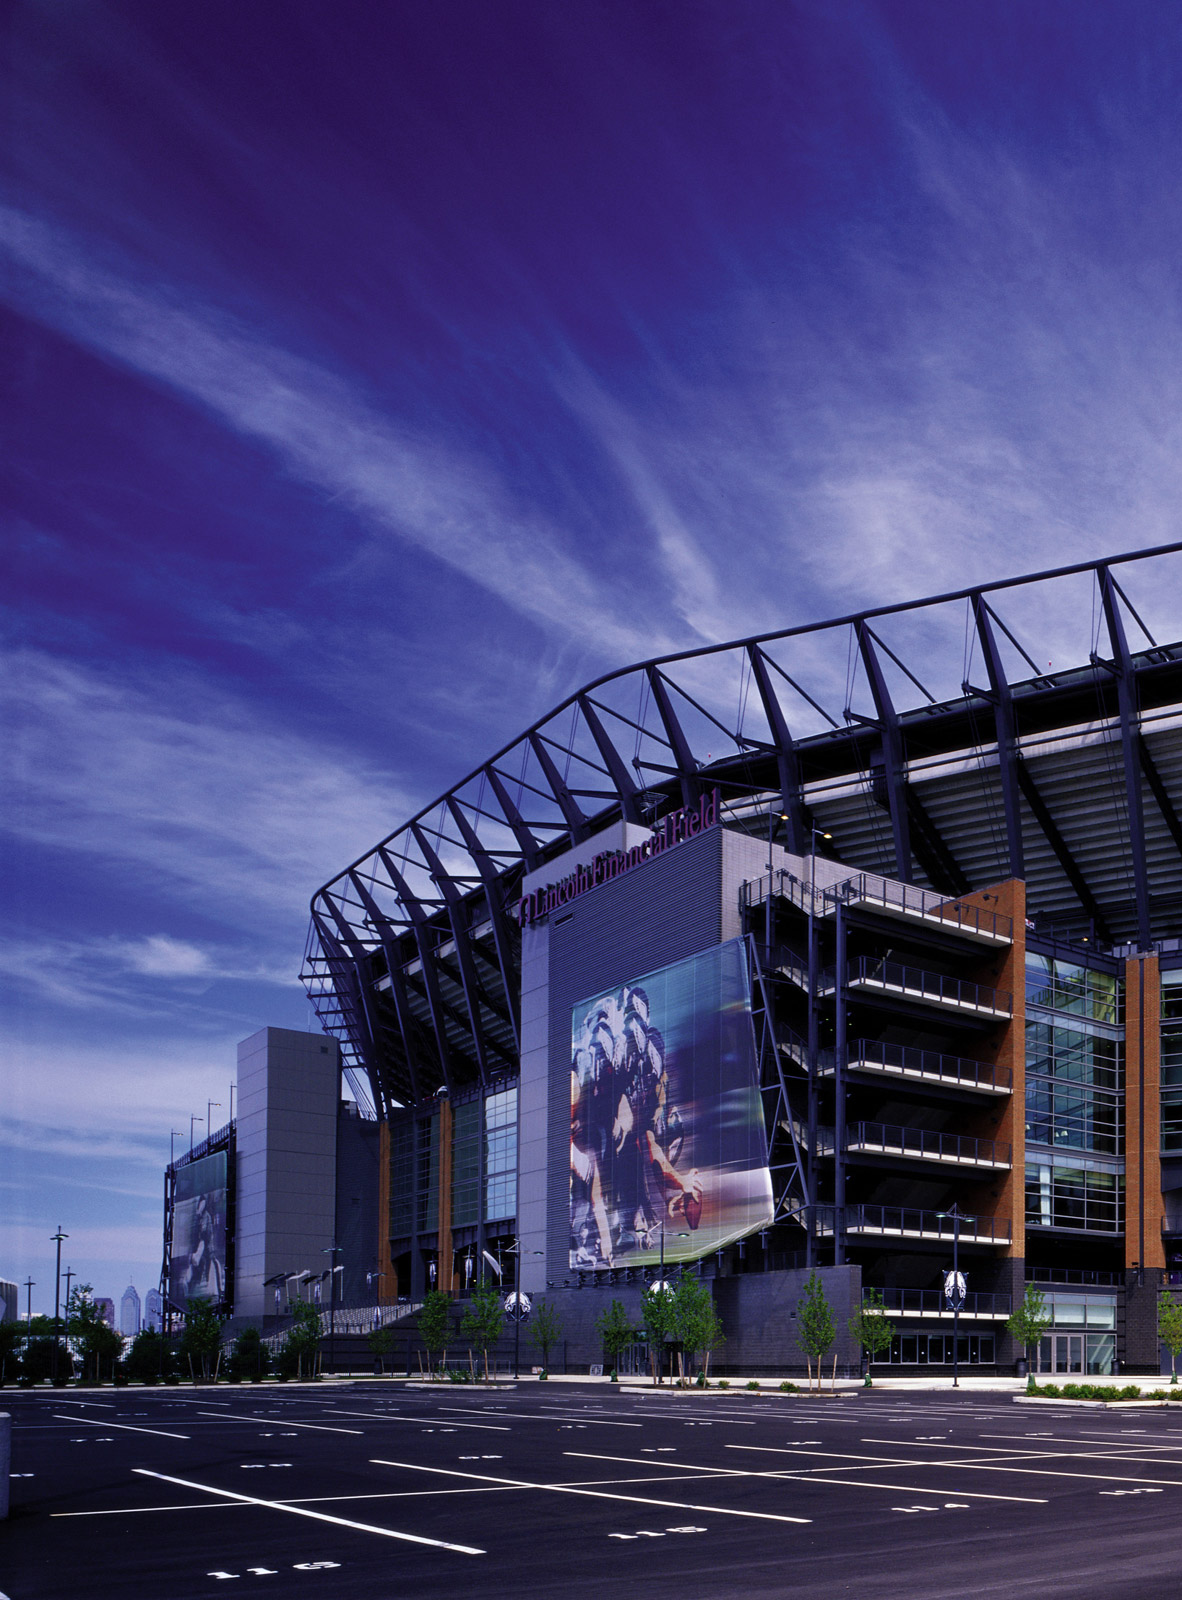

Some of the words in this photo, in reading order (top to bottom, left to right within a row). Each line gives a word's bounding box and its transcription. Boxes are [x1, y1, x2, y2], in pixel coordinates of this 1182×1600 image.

[532, 863, 590, 920] Lincoln
[591, 815, 668, 888] Financial
[672, 787, 718, 846] Field
[607, 1525, 709, 1540] 115
[206, 1561, 343, 1581] 116
